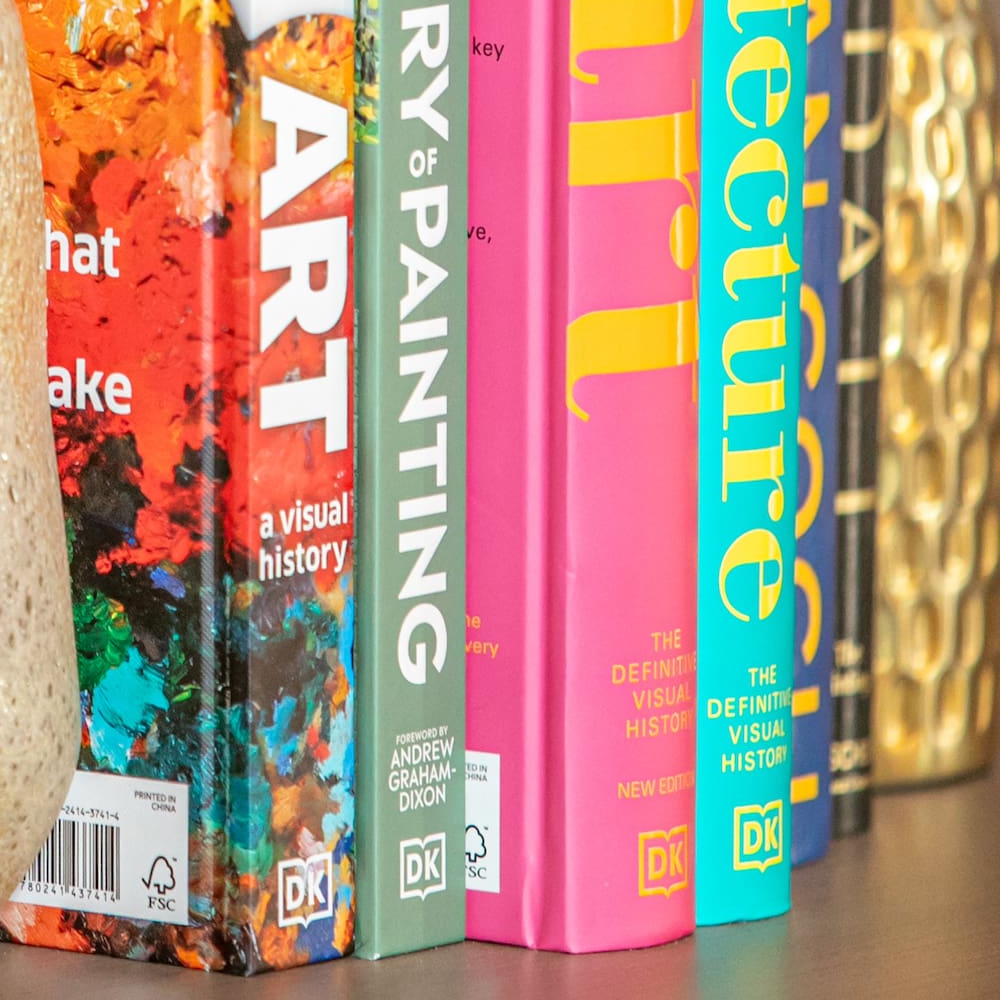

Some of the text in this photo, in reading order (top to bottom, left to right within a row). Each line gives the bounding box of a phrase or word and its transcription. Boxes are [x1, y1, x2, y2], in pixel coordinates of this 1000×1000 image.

[472, 35, 505, 62] key
[408, 147, 438, 178] OF
[260, 75, 349, 454] ART
[47, 357, 133, 415] ake
[397, 184, 449, 685] PAINTING
[259, 492, 348, 539] a visual
[259, 539, 348, 582] history
[650, 628, 681, 652] THE
[748, 664, 777, 687] THE
[632, 682, 691, 711] VISUAL
[396, 725, 448, 746] FOREWORD BY
[728, 719, 786, 745] VISUAL
[390, 736, 455, 770] ANDREW
[721, 745, 787, 774] HISTORY
[388, 760, 457, 793] GRAHAM-
[465, 763, 488, 773] ED IN
[134, 790, 177, 803] PRINTED IN
[399, 783, 447, 813] DIXON
[617, 779, 656, 800] NEW
[151, 802, 177, 813] CHINA
[742, 815, 780, 856] DK
[405, 847, 441, 885] DK
[465, 865, 488, 879] SC
[647, 840, 684, 881] DK
[147, 895, 177, 911] FSC
[285, 869, 327, 911] DK
